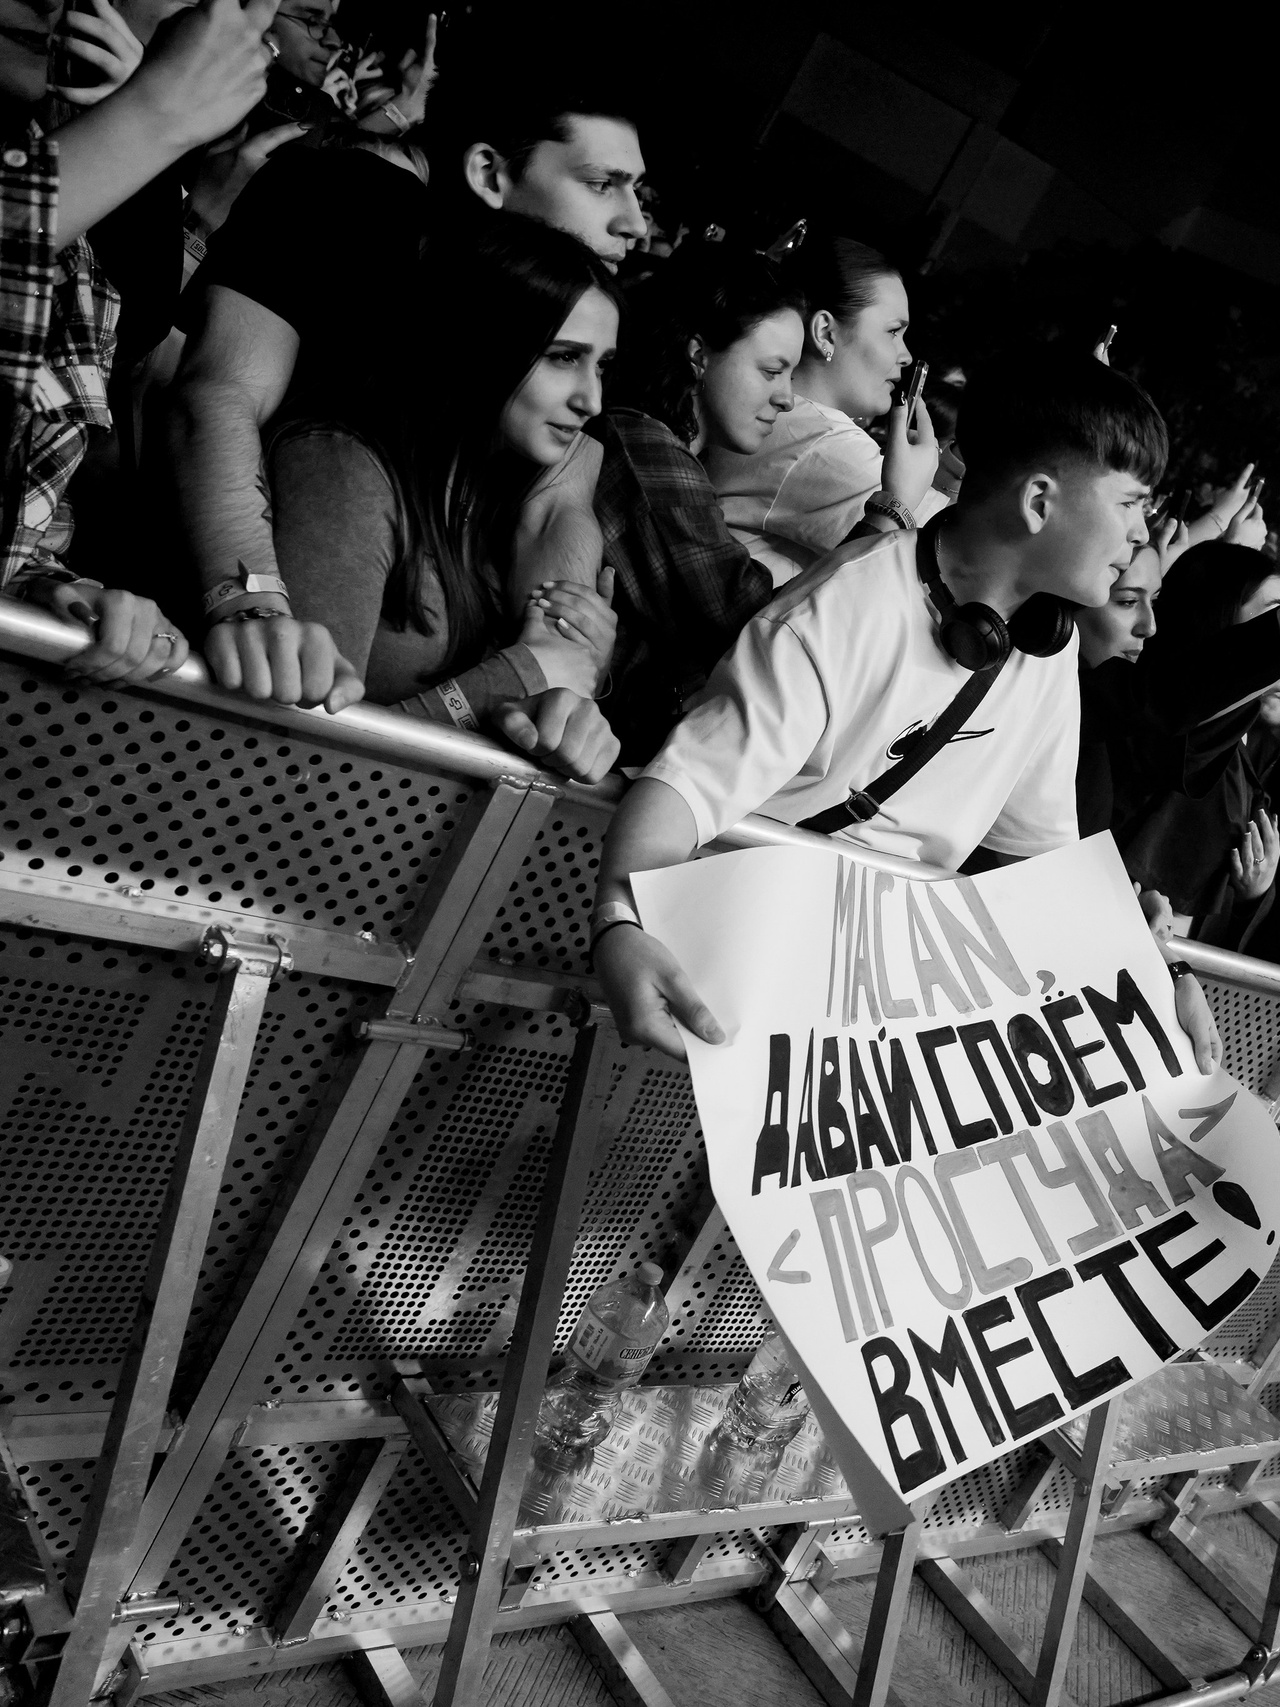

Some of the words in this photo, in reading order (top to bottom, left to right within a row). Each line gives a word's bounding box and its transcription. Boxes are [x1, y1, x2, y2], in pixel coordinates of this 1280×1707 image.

[826, 855, 1055, 1027] MACAN,
[752, 1027, 938, 1196] ДАВАЙ
[919, 967, 1184, 1149] СПОЁМ
[860, 1180, 1276, 1494] ВМЕСТЕ!
